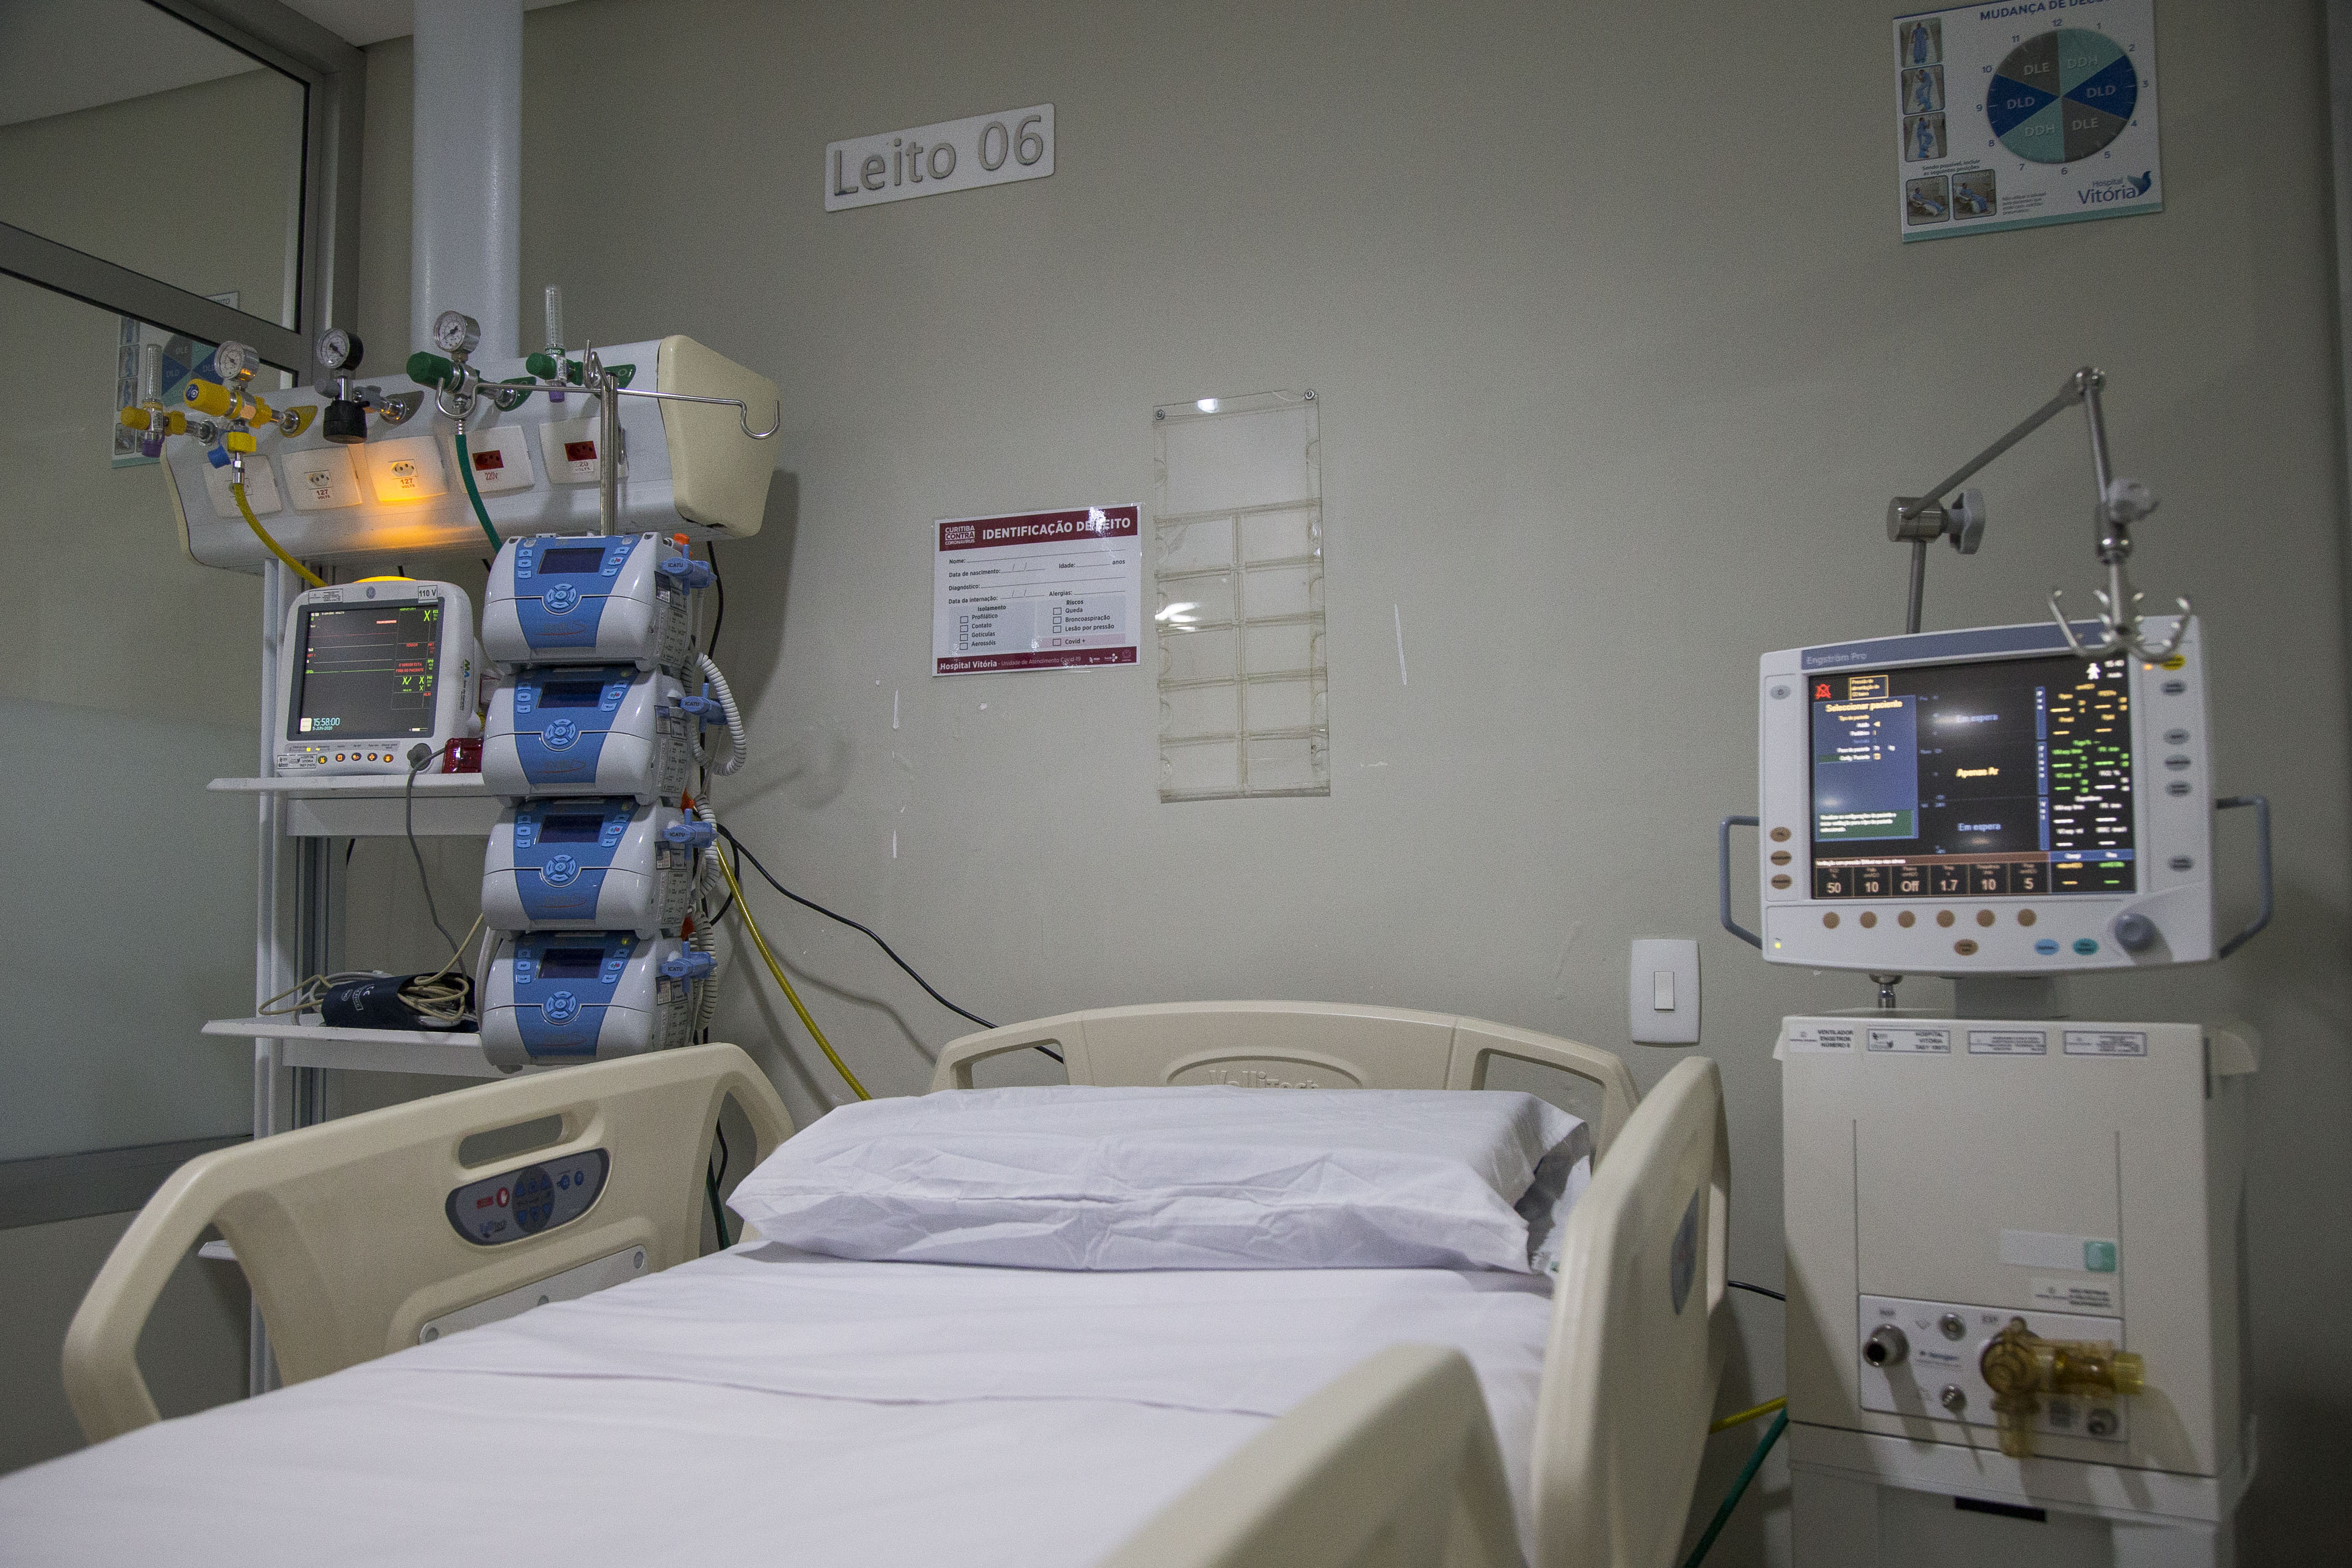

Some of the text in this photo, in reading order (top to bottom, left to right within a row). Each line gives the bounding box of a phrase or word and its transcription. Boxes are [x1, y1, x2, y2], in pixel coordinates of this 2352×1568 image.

[1980, 0, 2066, 21] MUDANÇA DE
[2024, 62, 2050, 75] DLE
[2066, 56, 2098, 70] DDH
[2086, 85, 2116, 98] DLD
[2007, 96, 2035, 109] DLD
[2024, 123, 2056, 137] DDH
[2072, 118, 2099, 131] DLE
[834, 115, 1044, 196] Leito 06
[2092, 178, 2123, 188] Hospital
[2077, 185, 2136, 204] Vitória
[485, 472, 498, 480] 220V
[983, 520, 1073, 540] IDENTIFICAÇÃO
[1096, 517, 1131, 531] EITO
[946, 531, 974, 540] CONTRA
[423, 610, 430, 621] X
[1065, 614, 1110, 623] Broncoaspiração
[1806, 653, 1849, 665] Engström
[940, 661, 970, 670] Hospital
[973, 660, 997, 668] Vitória
[1869, 700, 1903, 711] paciente
[313, 718, 340, 726] 15:58:00
[1970, 714, 1999, 723] espera
[1956, 767, 1999, 779] Apenas Ar
[1958, 823, 2002, 833] Em espera
[1826, 882, 1842, 893] 50
[1865, 881, 1879, 892] 10
[1900, 881, 1920, 892] Off
[1941, 880, 1958, 891] 1.7
[1982, 879, 1996, 891] 10
[2024, 878, 2034, 890] 5
